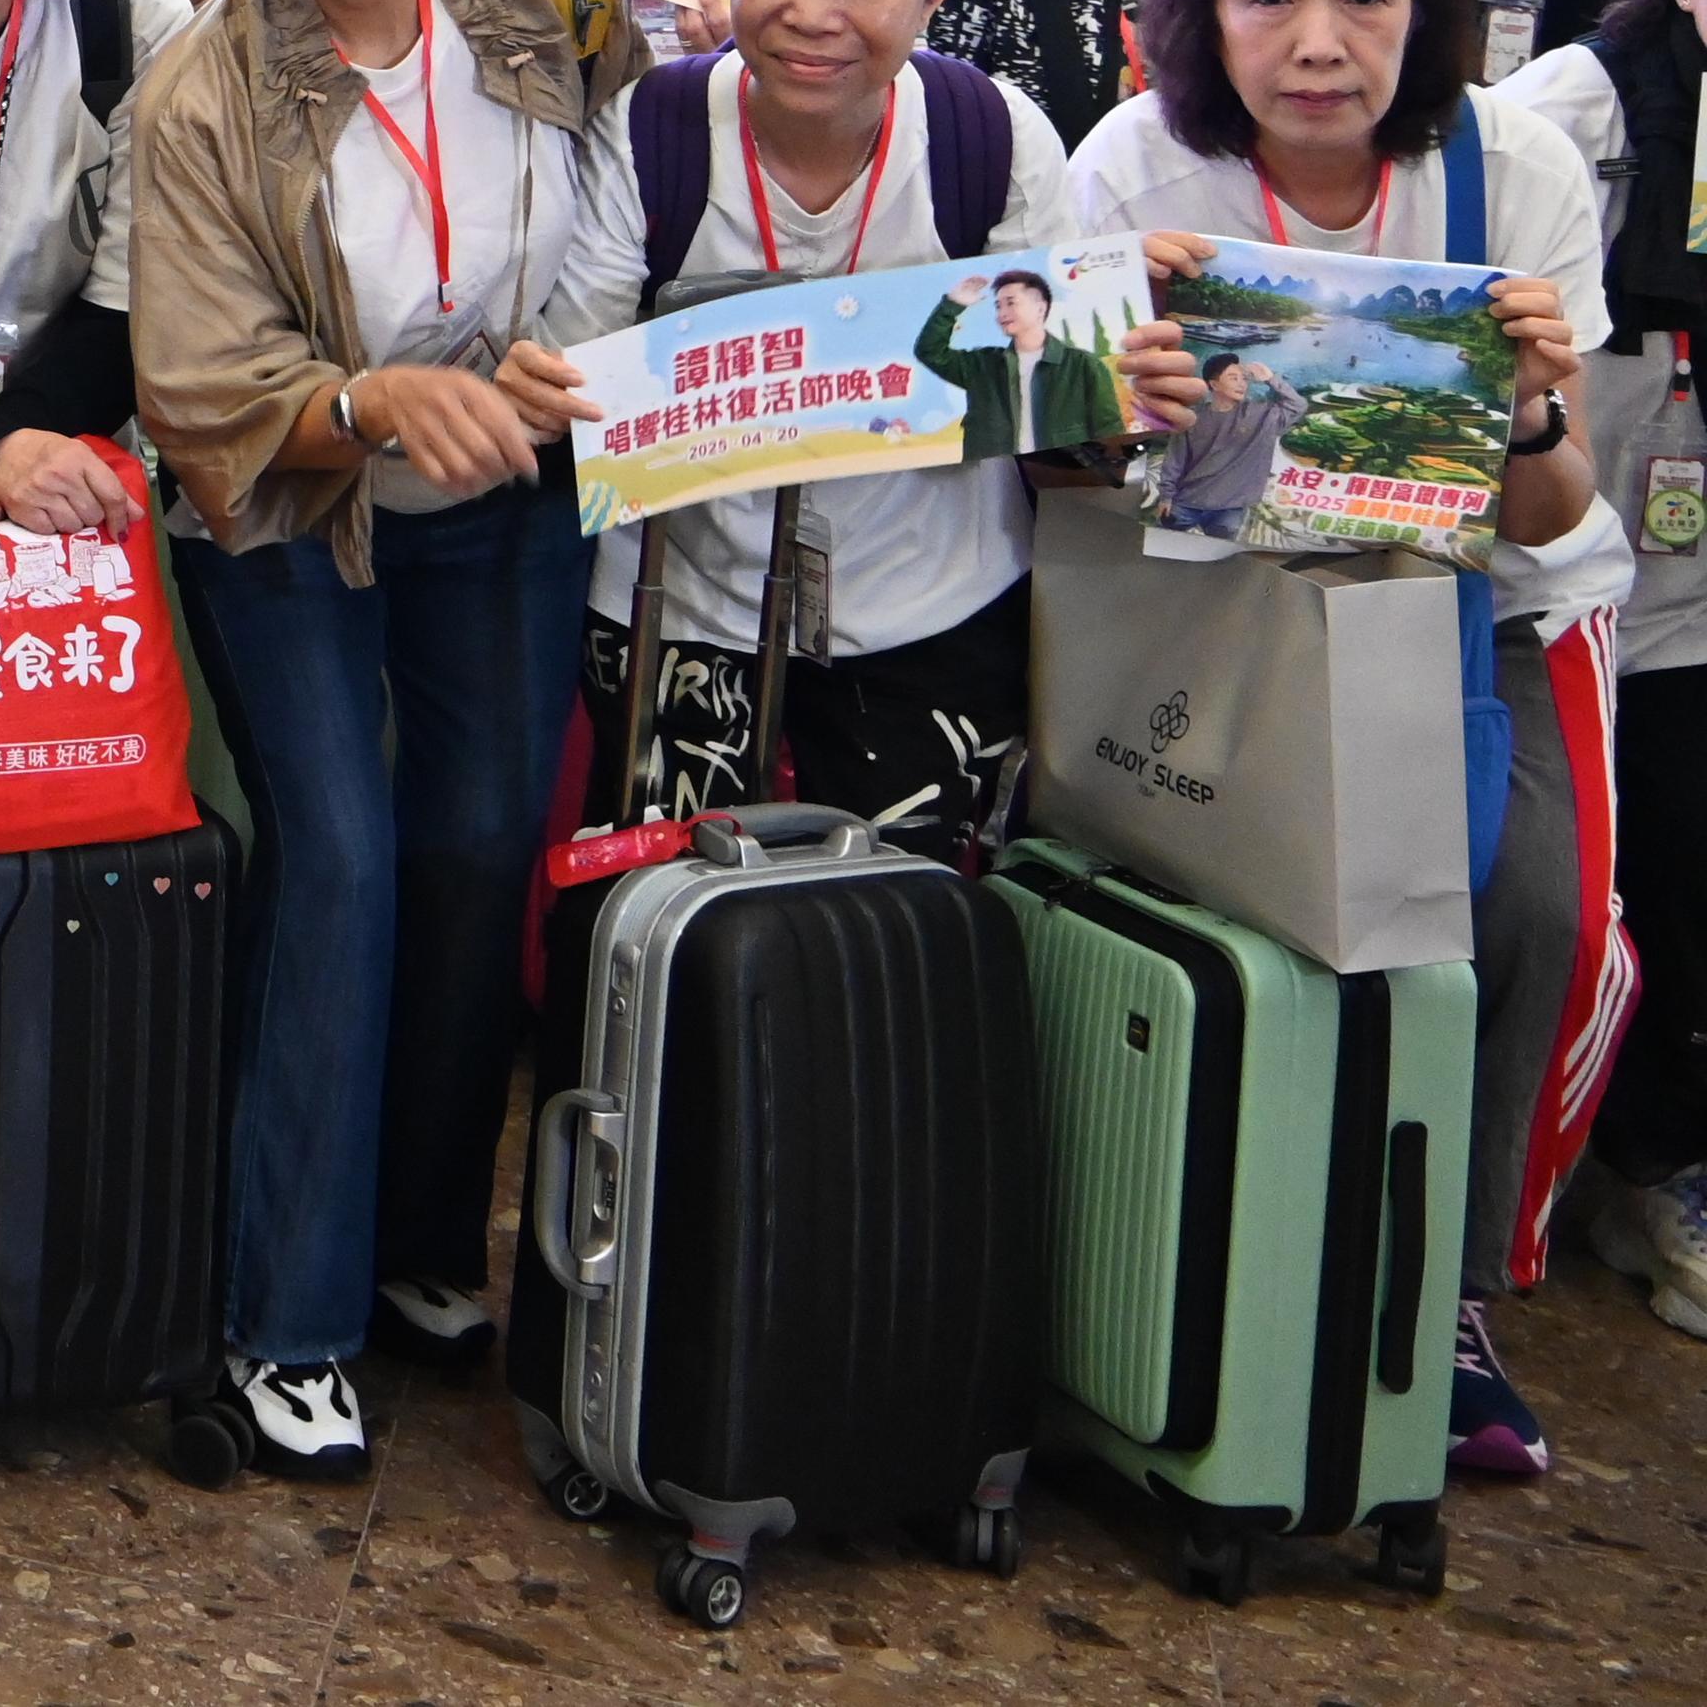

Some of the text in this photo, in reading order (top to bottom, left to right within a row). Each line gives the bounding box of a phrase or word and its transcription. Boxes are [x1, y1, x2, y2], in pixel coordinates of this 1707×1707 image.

[672, 324, 805, 396] 譚輝智
[603, 361, 913, 458] 唱響桂林復活節晚會
[55, 736, 142, 767] 好吃不贵
[1094, 735, 1215, 807] ENJOY SLEEP
